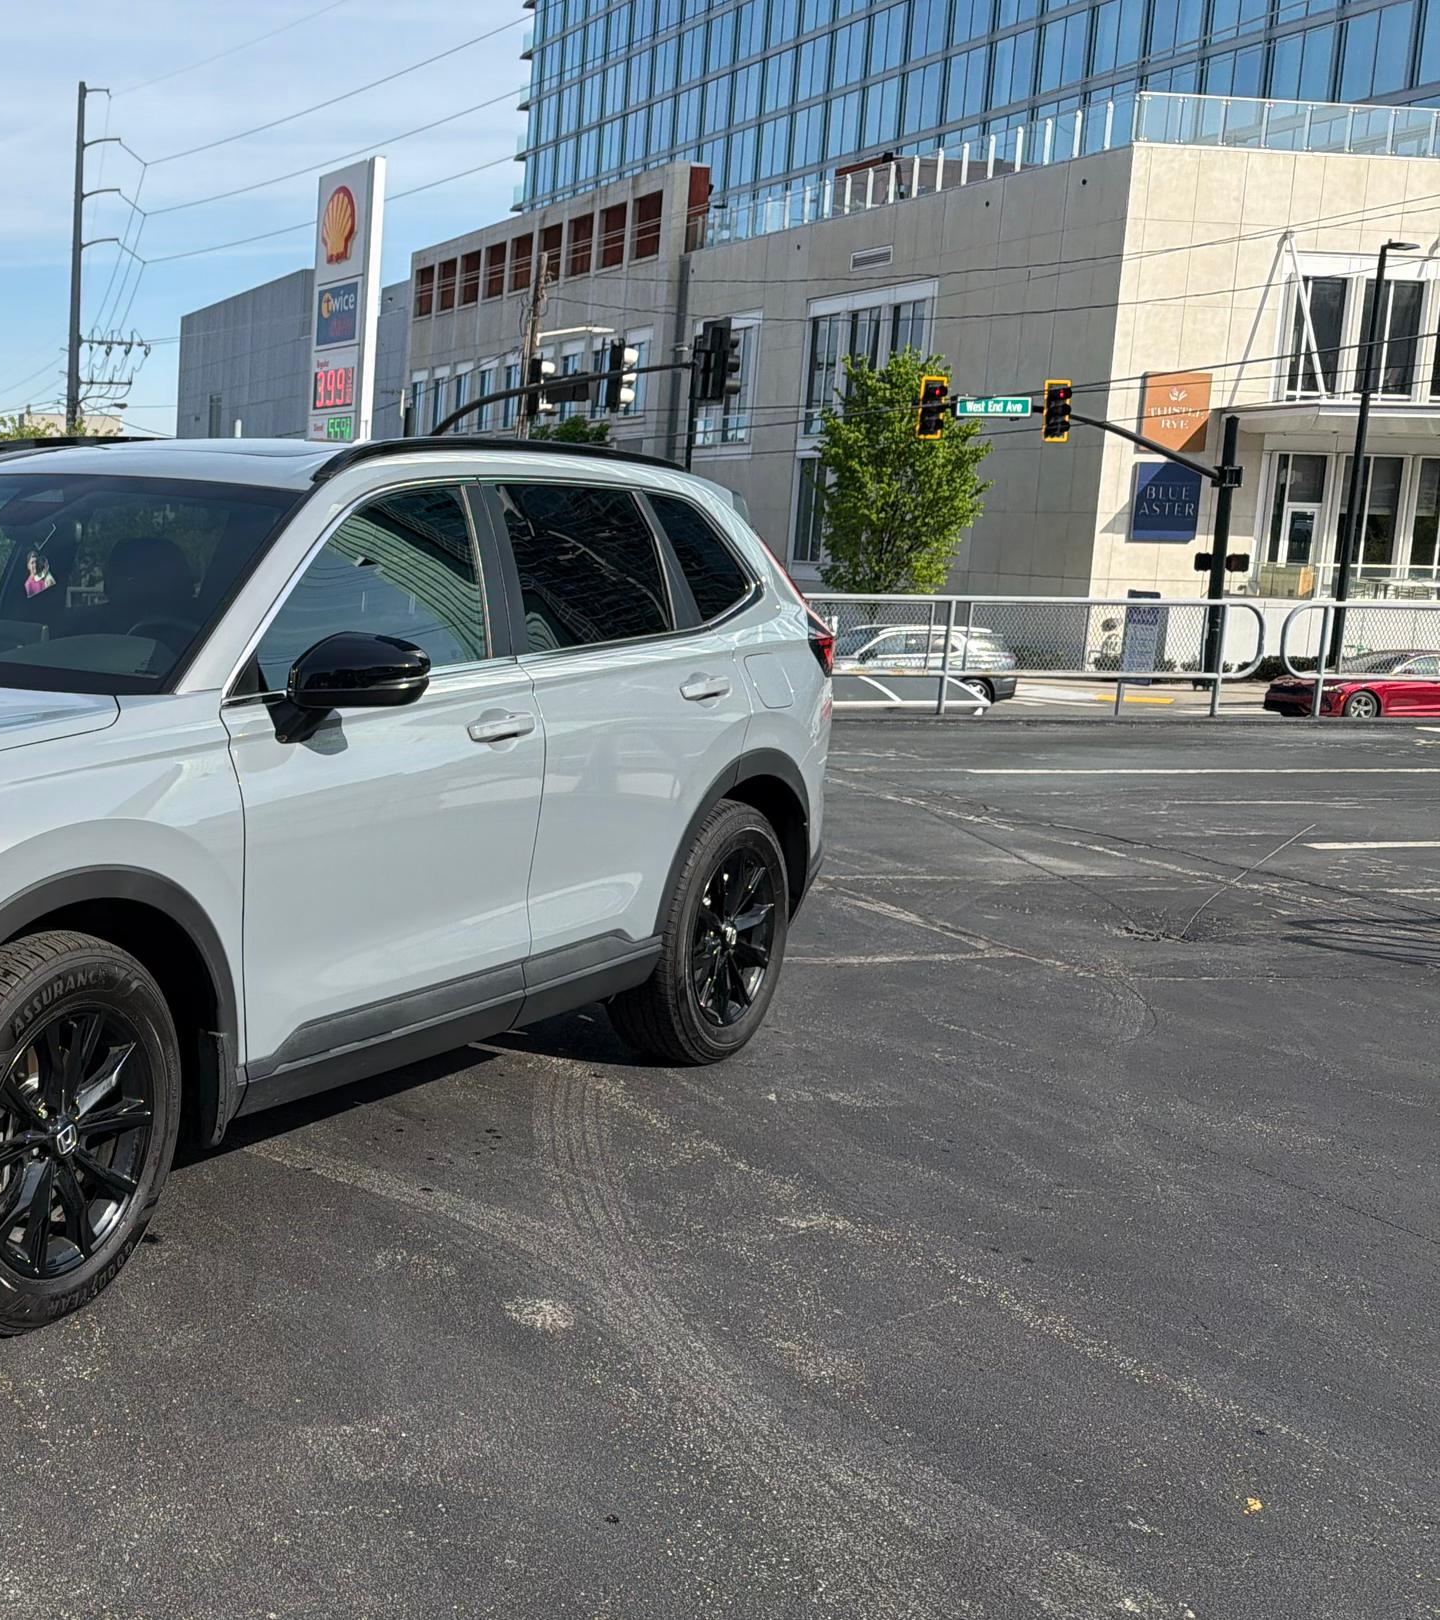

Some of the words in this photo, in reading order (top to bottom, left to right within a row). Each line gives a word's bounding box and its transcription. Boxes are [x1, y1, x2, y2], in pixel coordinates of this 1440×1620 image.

[966, 400, 985, 412] West
[988, 400, 1003, 412] End
[1006, 400, 1023, 412] Ave
[1161, 418, 1189, 430] RYE
[1146, 485, 1190, 500] BLUE
[1139, 502, 1195, 516] ASTER
